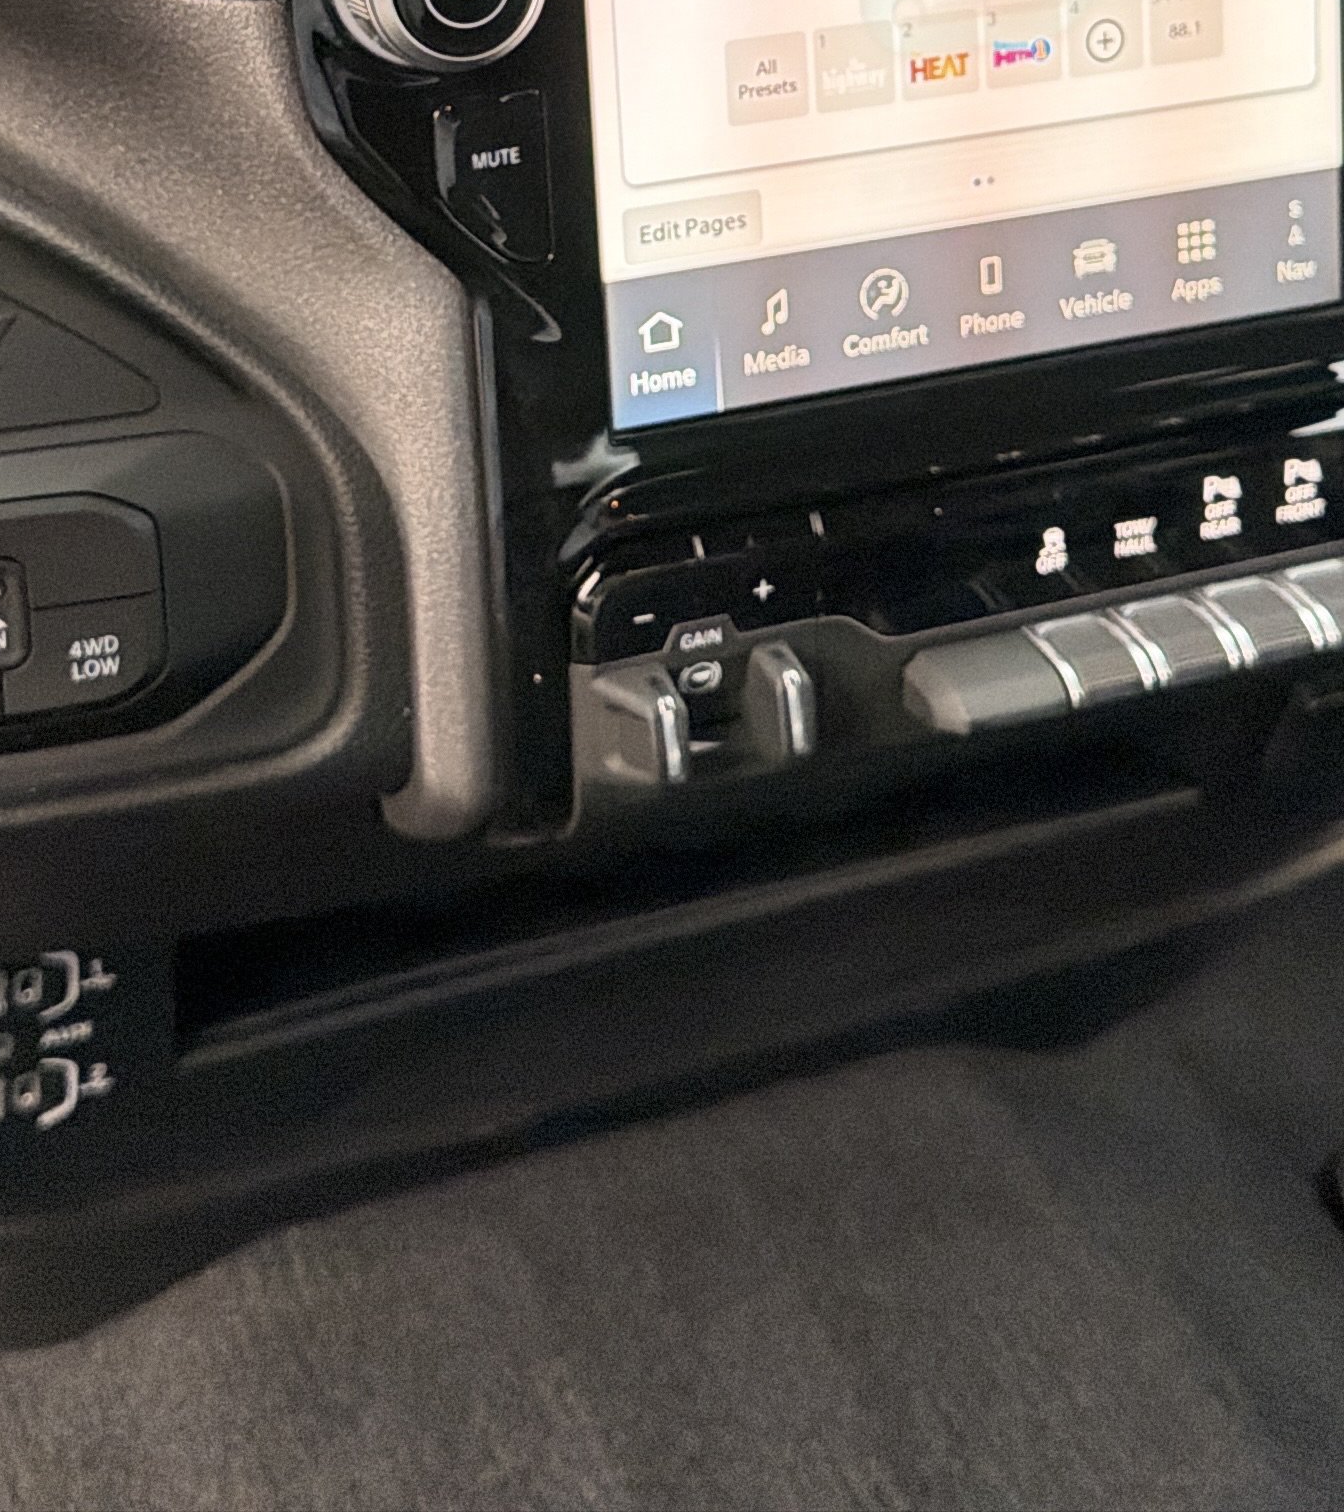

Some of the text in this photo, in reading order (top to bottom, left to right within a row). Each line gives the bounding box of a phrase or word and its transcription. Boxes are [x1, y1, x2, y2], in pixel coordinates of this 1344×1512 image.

[903, 23, 912, 37] 2
[757, 59, 777, 76] All
[910, 52, 969, 83] HEAT
[738, 80, 798, 100] Presets
[471, 146, 521, 169] MUTE
[639, 213, 747, 245] Edit Pages
[1276, 259, 1317, 283] Nav
[1171, 276, 1223, 303] Apps
[1059, 288, 1133, 320] Vehicle
[959, 306, 1026, 338] Phone
[842, 324, 929, 358] Comfort
[743, 344, 810, 377] Media
[630, 367, 696, 396] Home
[68, 634, 120, 659] 4WD
[679, 626, 723, 652] GAIN
[70, 654, 120, 681] LOW
